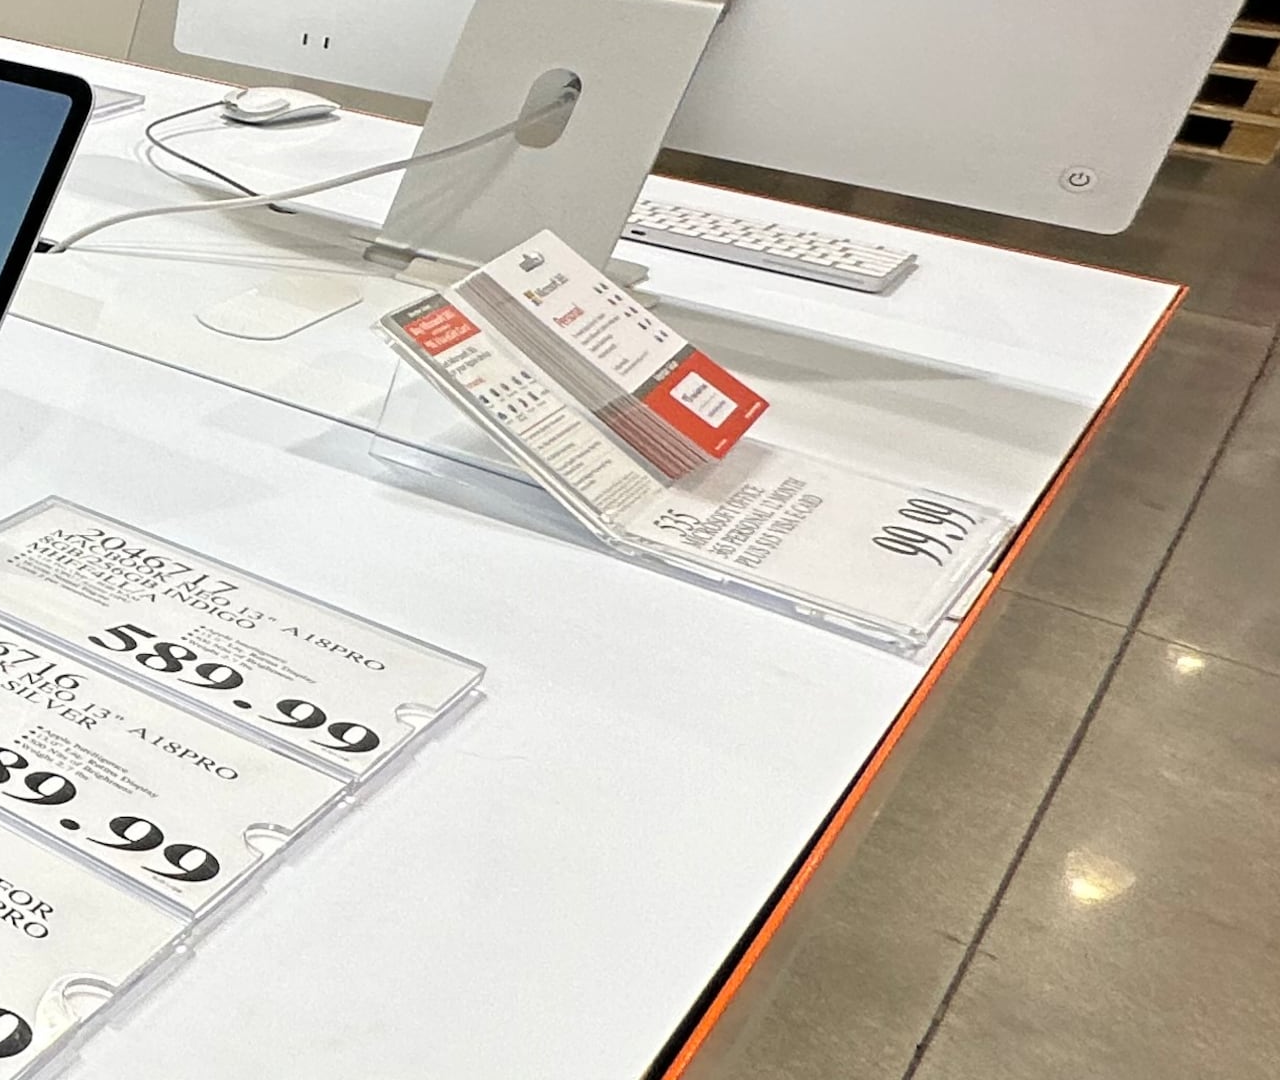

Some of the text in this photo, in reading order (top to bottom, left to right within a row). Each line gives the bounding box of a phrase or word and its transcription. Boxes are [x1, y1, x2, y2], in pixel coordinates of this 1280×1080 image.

[767, 476, 806, 503] MONTH
[653, 508, 704, 536] 535
[680, 483, 765, 549] MICROSOFT OFFICE
[720, 508, 775, 546] PERSONAL
[872, 498, 984, 566] 99.99
[72, 529, 238, 593] 2046717
[707, 542, 736, 558] 365
[733, 545, 770, 568] PLUS
[767, 517, 800, 534] VISA
[27, 542, 155, 602] MHFF4LL/A
[39, 536, 157, 588] 8GB/256GB
[162, 588, 255, 628] INDIGO
[51, 529, 170, 582] MACBOOK
[176, 582, 230, 606] NEO
[238, 607, 276, 621] 13"
[281, 627, 384, 670] A18PRO
[1, 681, 96, 729] SILVER
[88, 624, 379, 752] 589.99
[19, 672, 75, 701] NEO
[83, 704, 123, 720] 13"
[128, 728, 238, 779] A18PRO
[22, 743, 53, 762] Weight
[43, 730, 70, 744] Apple
[73, 743, 128, 773] Intelligence
[82, 765, 137, 794] Brightness
[120, 776, 158, 797] Display
